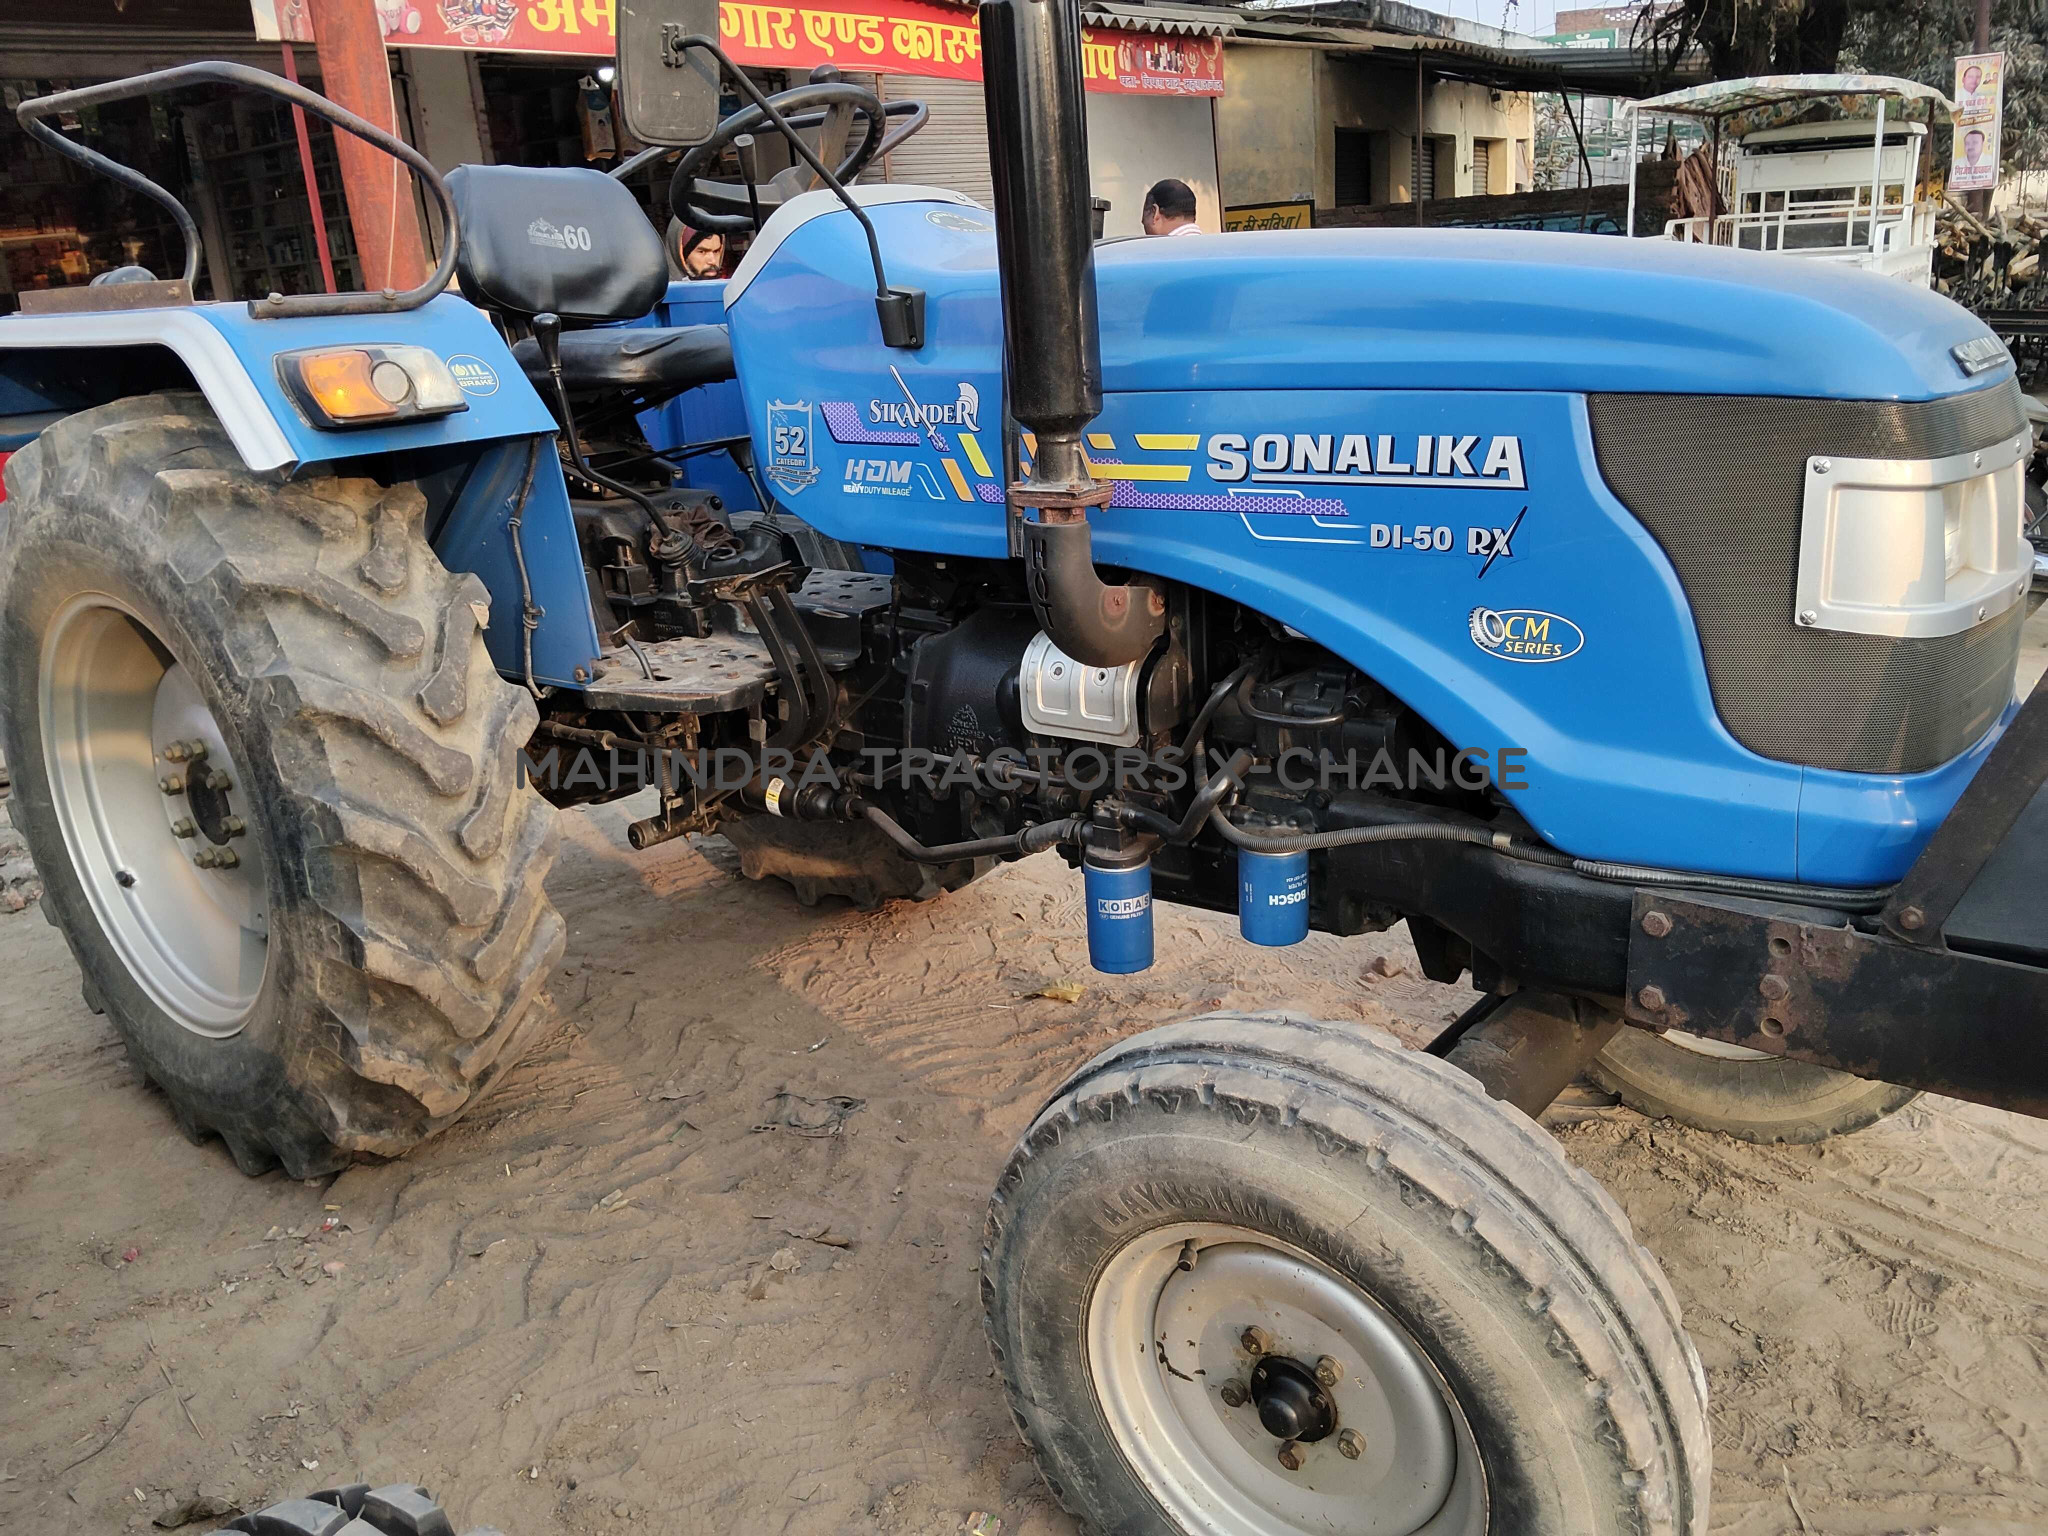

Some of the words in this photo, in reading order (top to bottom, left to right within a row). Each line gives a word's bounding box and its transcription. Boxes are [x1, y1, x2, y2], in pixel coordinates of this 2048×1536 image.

[718, 3, 797, 49] गार
[803, 10, 884, 57] एण्ड
[564, 225, 592, 251] 60
[451, 364, 489, 376] OIL
[459, 379, 496, 387] BRAKE
[869, 398, 981, 432] SIKANDER
[775, 426, 806, 455] 52
[776, 458, 806, 467] CATEGORY
[844, 458, 912, 484] HDM
[1206, 433, 1529, 490] SONALIKA
[843, 482, 864, 494] HEAVY
[864, 486, 881, 495] DUTY
[1369, 523, 1453, 553] DI-50
[1503, 640, 1563, 656] SERIES
[1099, 895, 1149, 912] KORAS
[1268, 888, 1307, 906] BOSCH
